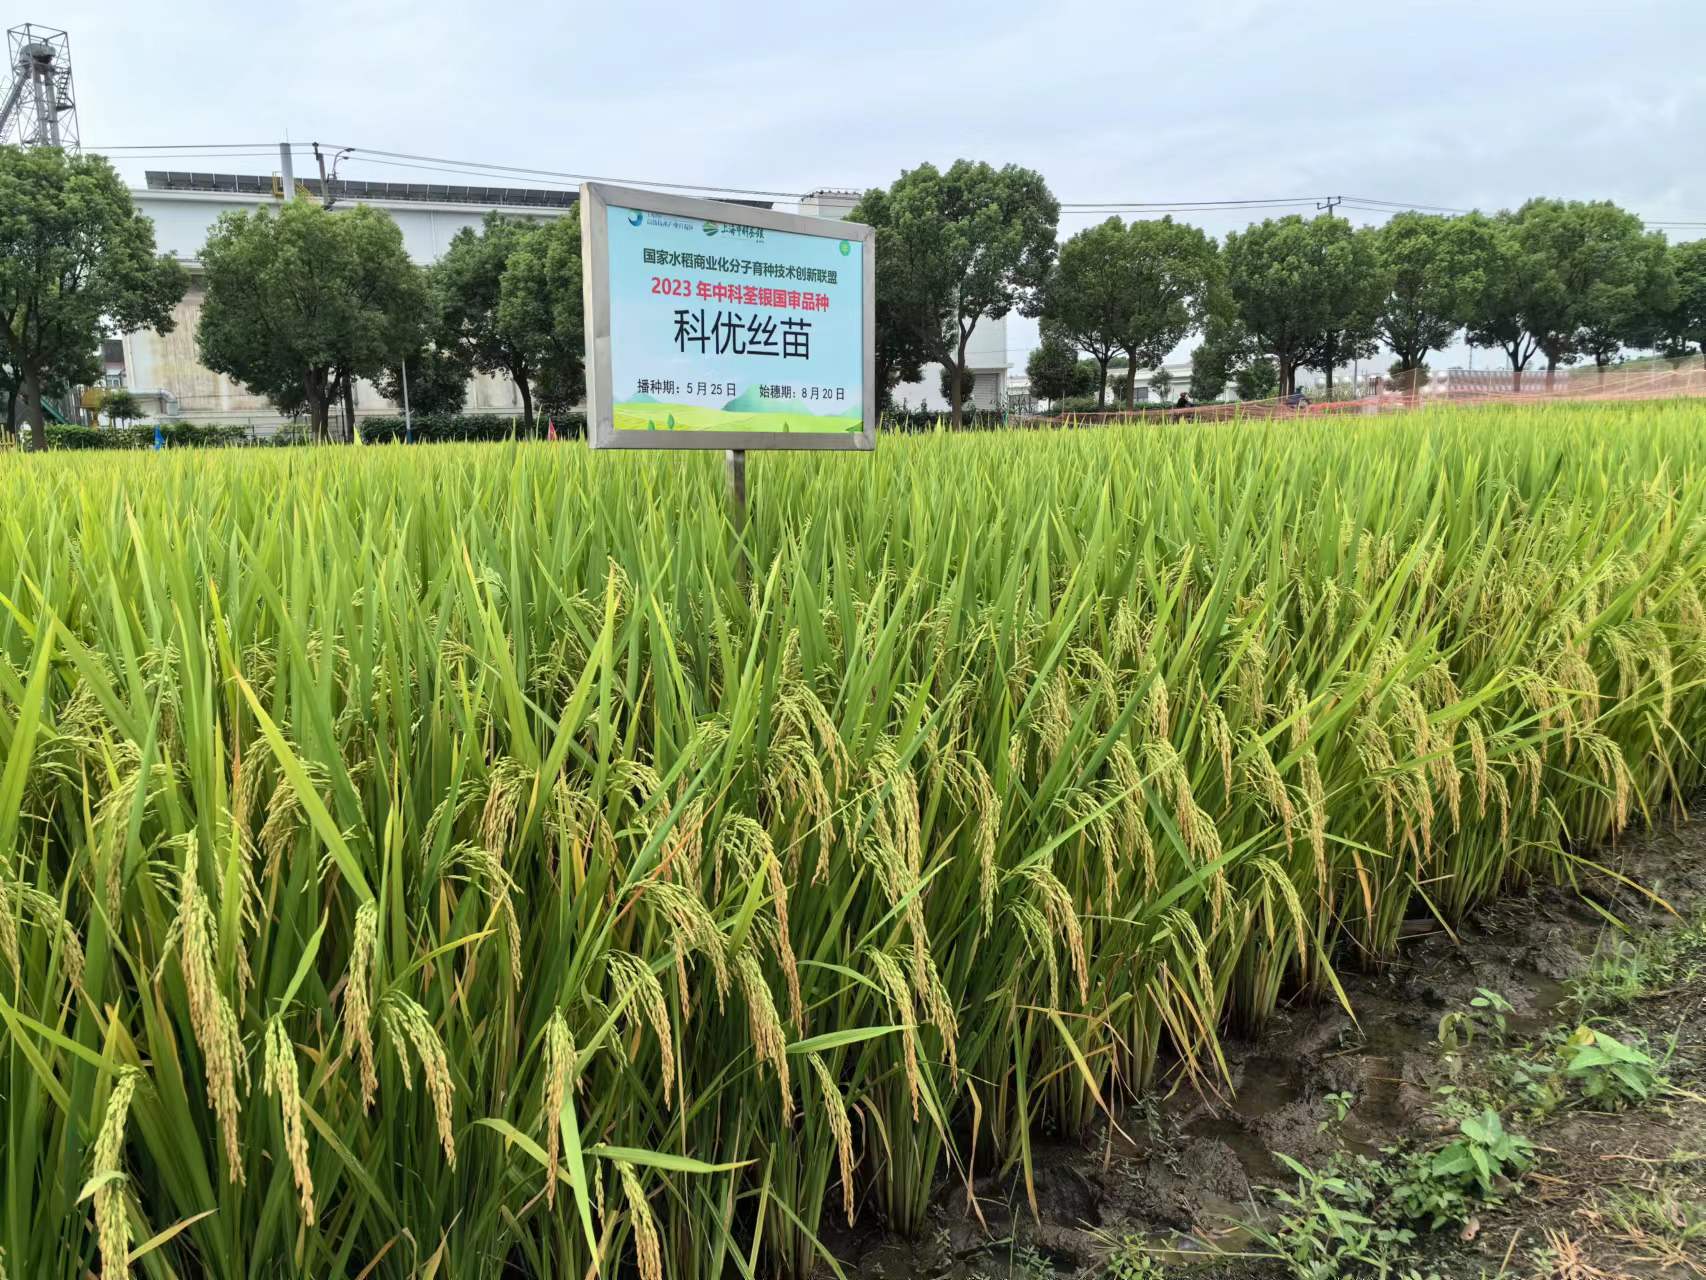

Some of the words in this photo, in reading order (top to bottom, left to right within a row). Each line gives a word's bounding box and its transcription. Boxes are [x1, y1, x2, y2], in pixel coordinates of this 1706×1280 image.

[643, 248, 837, 285] 国家水稻商业化分子育种技术创新联盟
[674, 309, 812, 360] 科优丝苗
